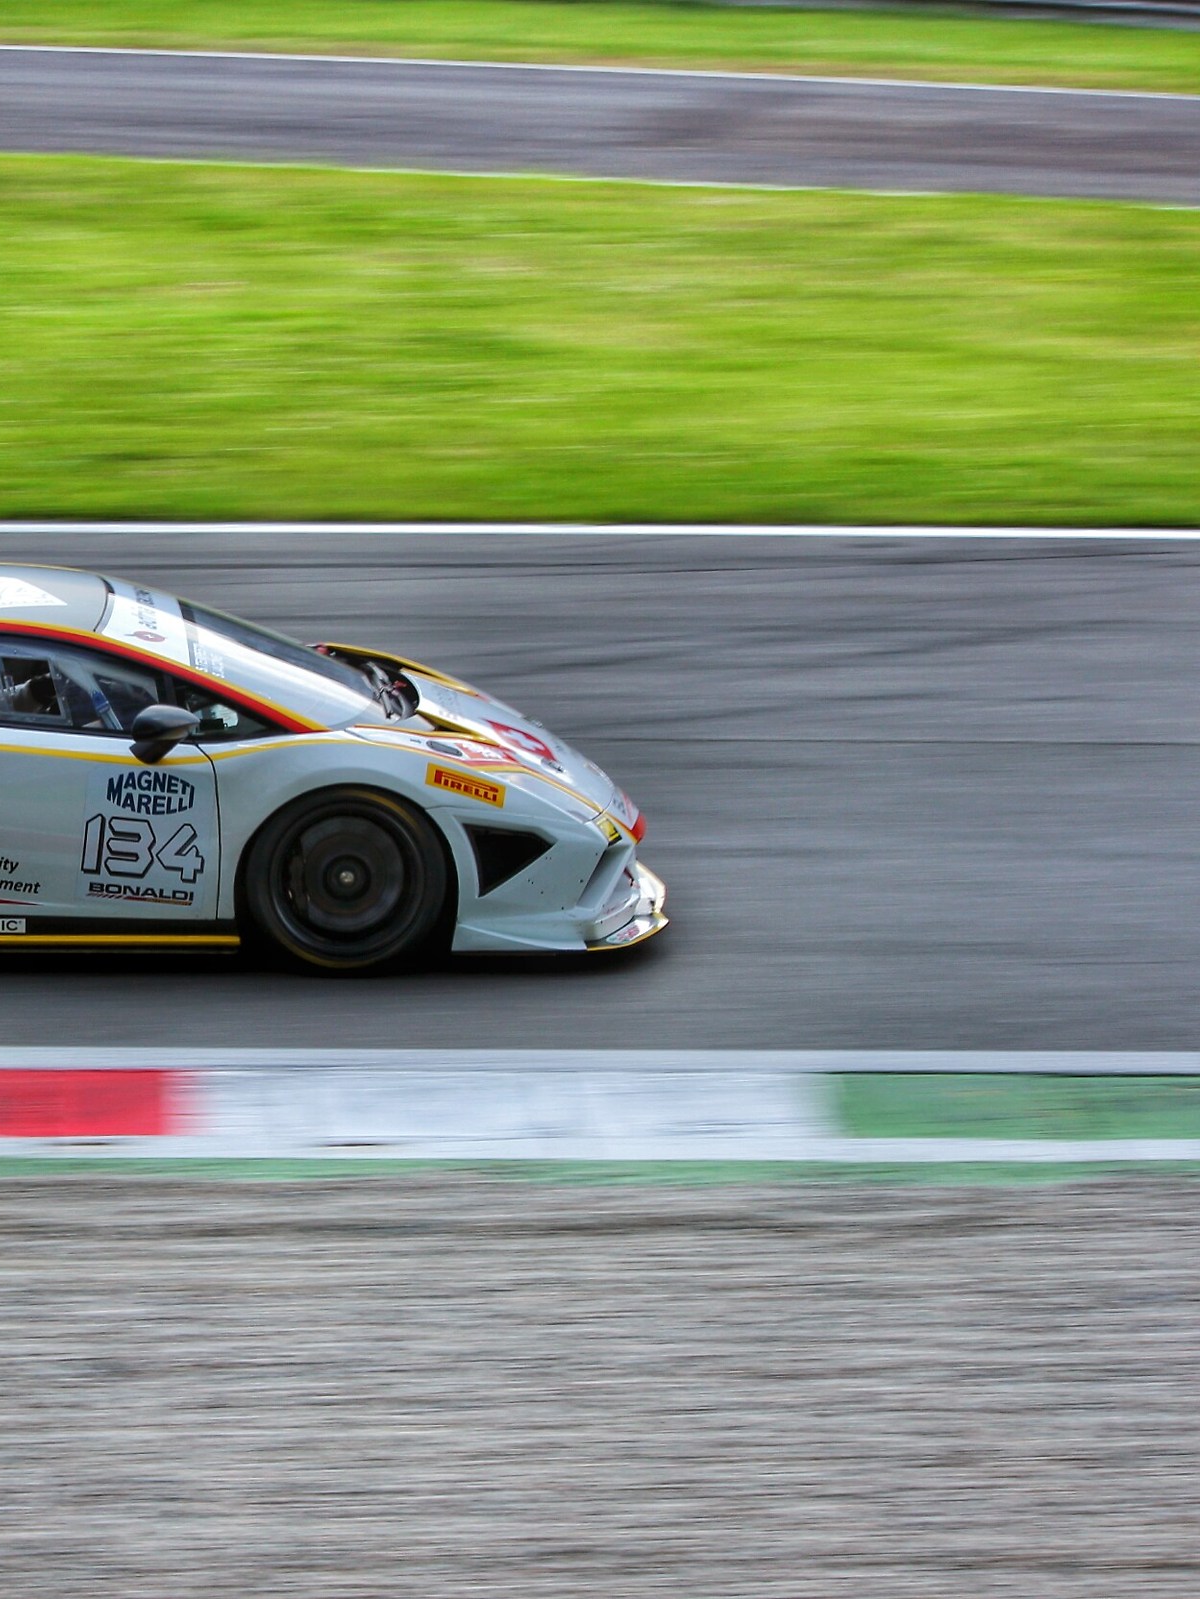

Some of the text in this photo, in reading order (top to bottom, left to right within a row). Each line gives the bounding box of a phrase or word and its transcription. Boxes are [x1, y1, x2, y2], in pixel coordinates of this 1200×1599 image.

[106, 770, 195, 801] MAGNETI
[106, 786, 194, 815] MARELLI
[434, 769, 499, 802] PIRELLI
[81, 813, 205, 883] 134
[88, 882, 194, 901] BONALDI
